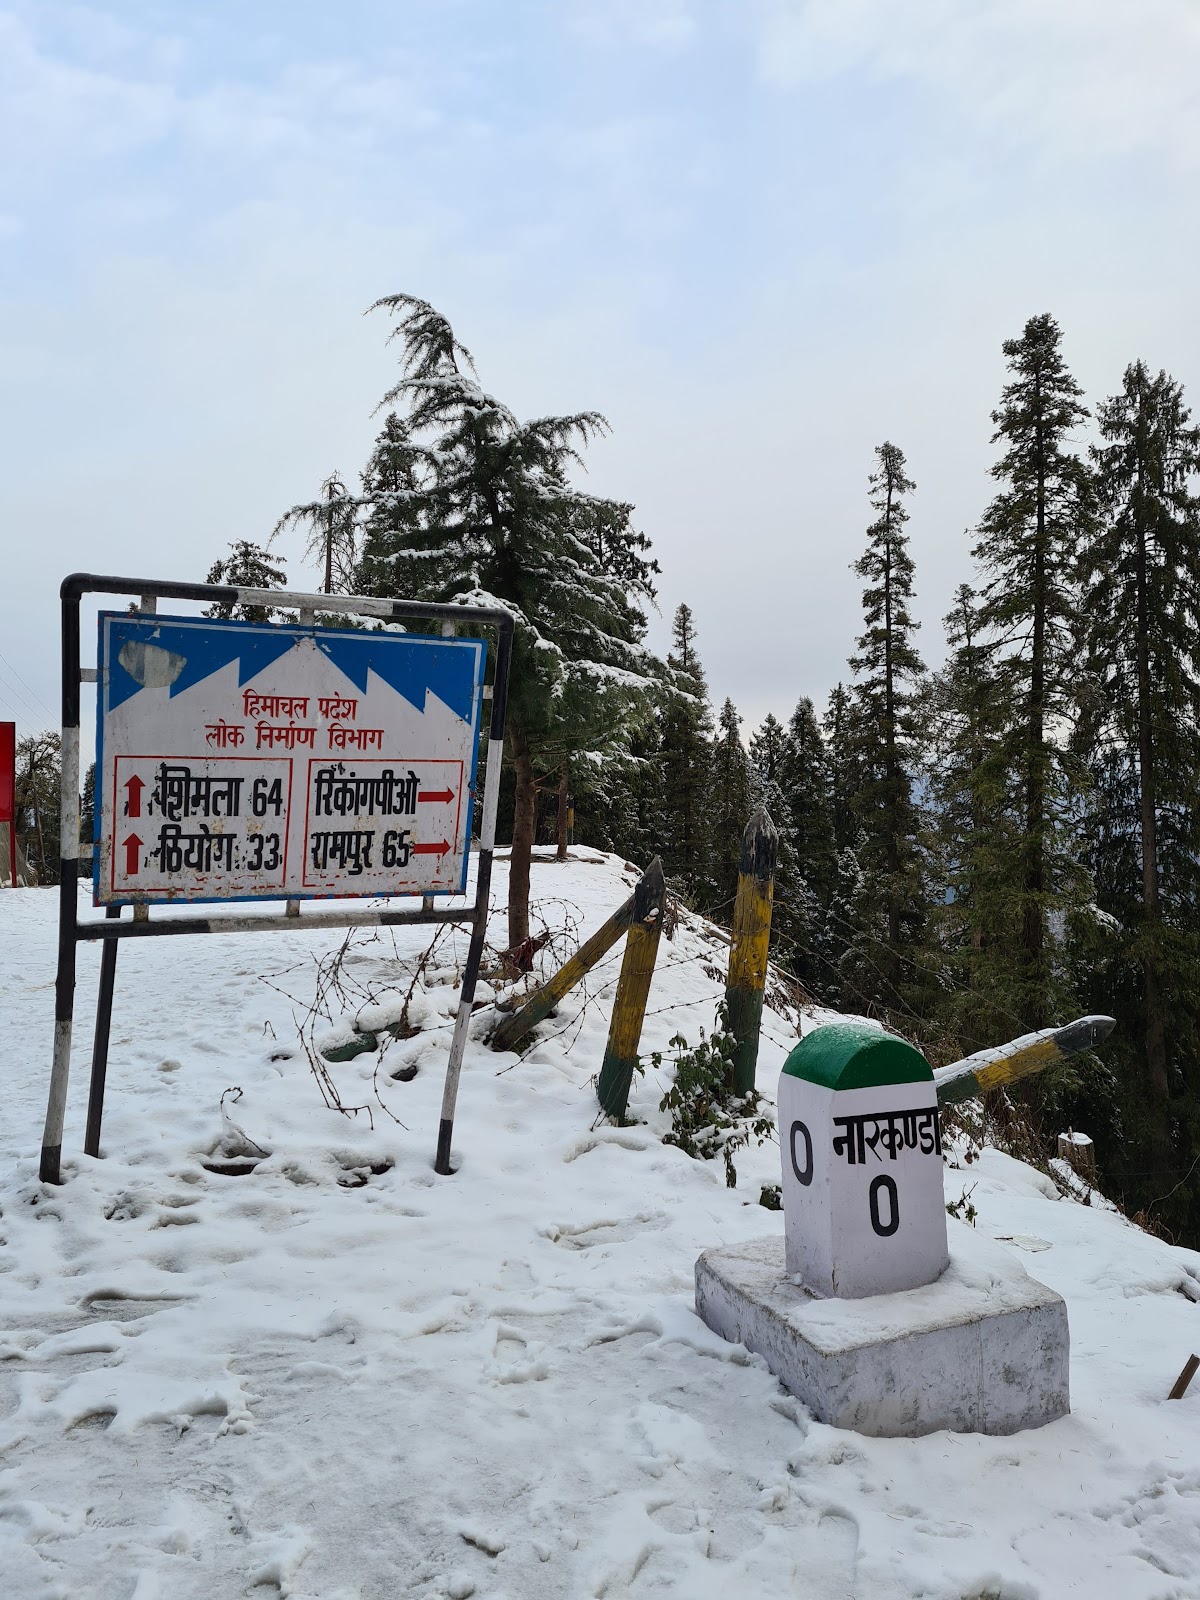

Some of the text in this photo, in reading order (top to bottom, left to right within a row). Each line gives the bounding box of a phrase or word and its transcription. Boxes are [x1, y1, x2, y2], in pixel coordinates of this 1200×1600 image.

[242, 689, 358, 721] हिमाचल प्रदेश
[205, 718, 384, 750] लोक निर्माण विभाग
[158, 766, 282, 822] शिमला 64
[158, 824, 279, 872] ठियोग 33
[311, 830, 410, 875] रामपुर 65
[790, 1120, 813, 1186] 0
[832, 1106, 942, 1164] नारकण्डा
[869, 1174, 899, 1237] 0
